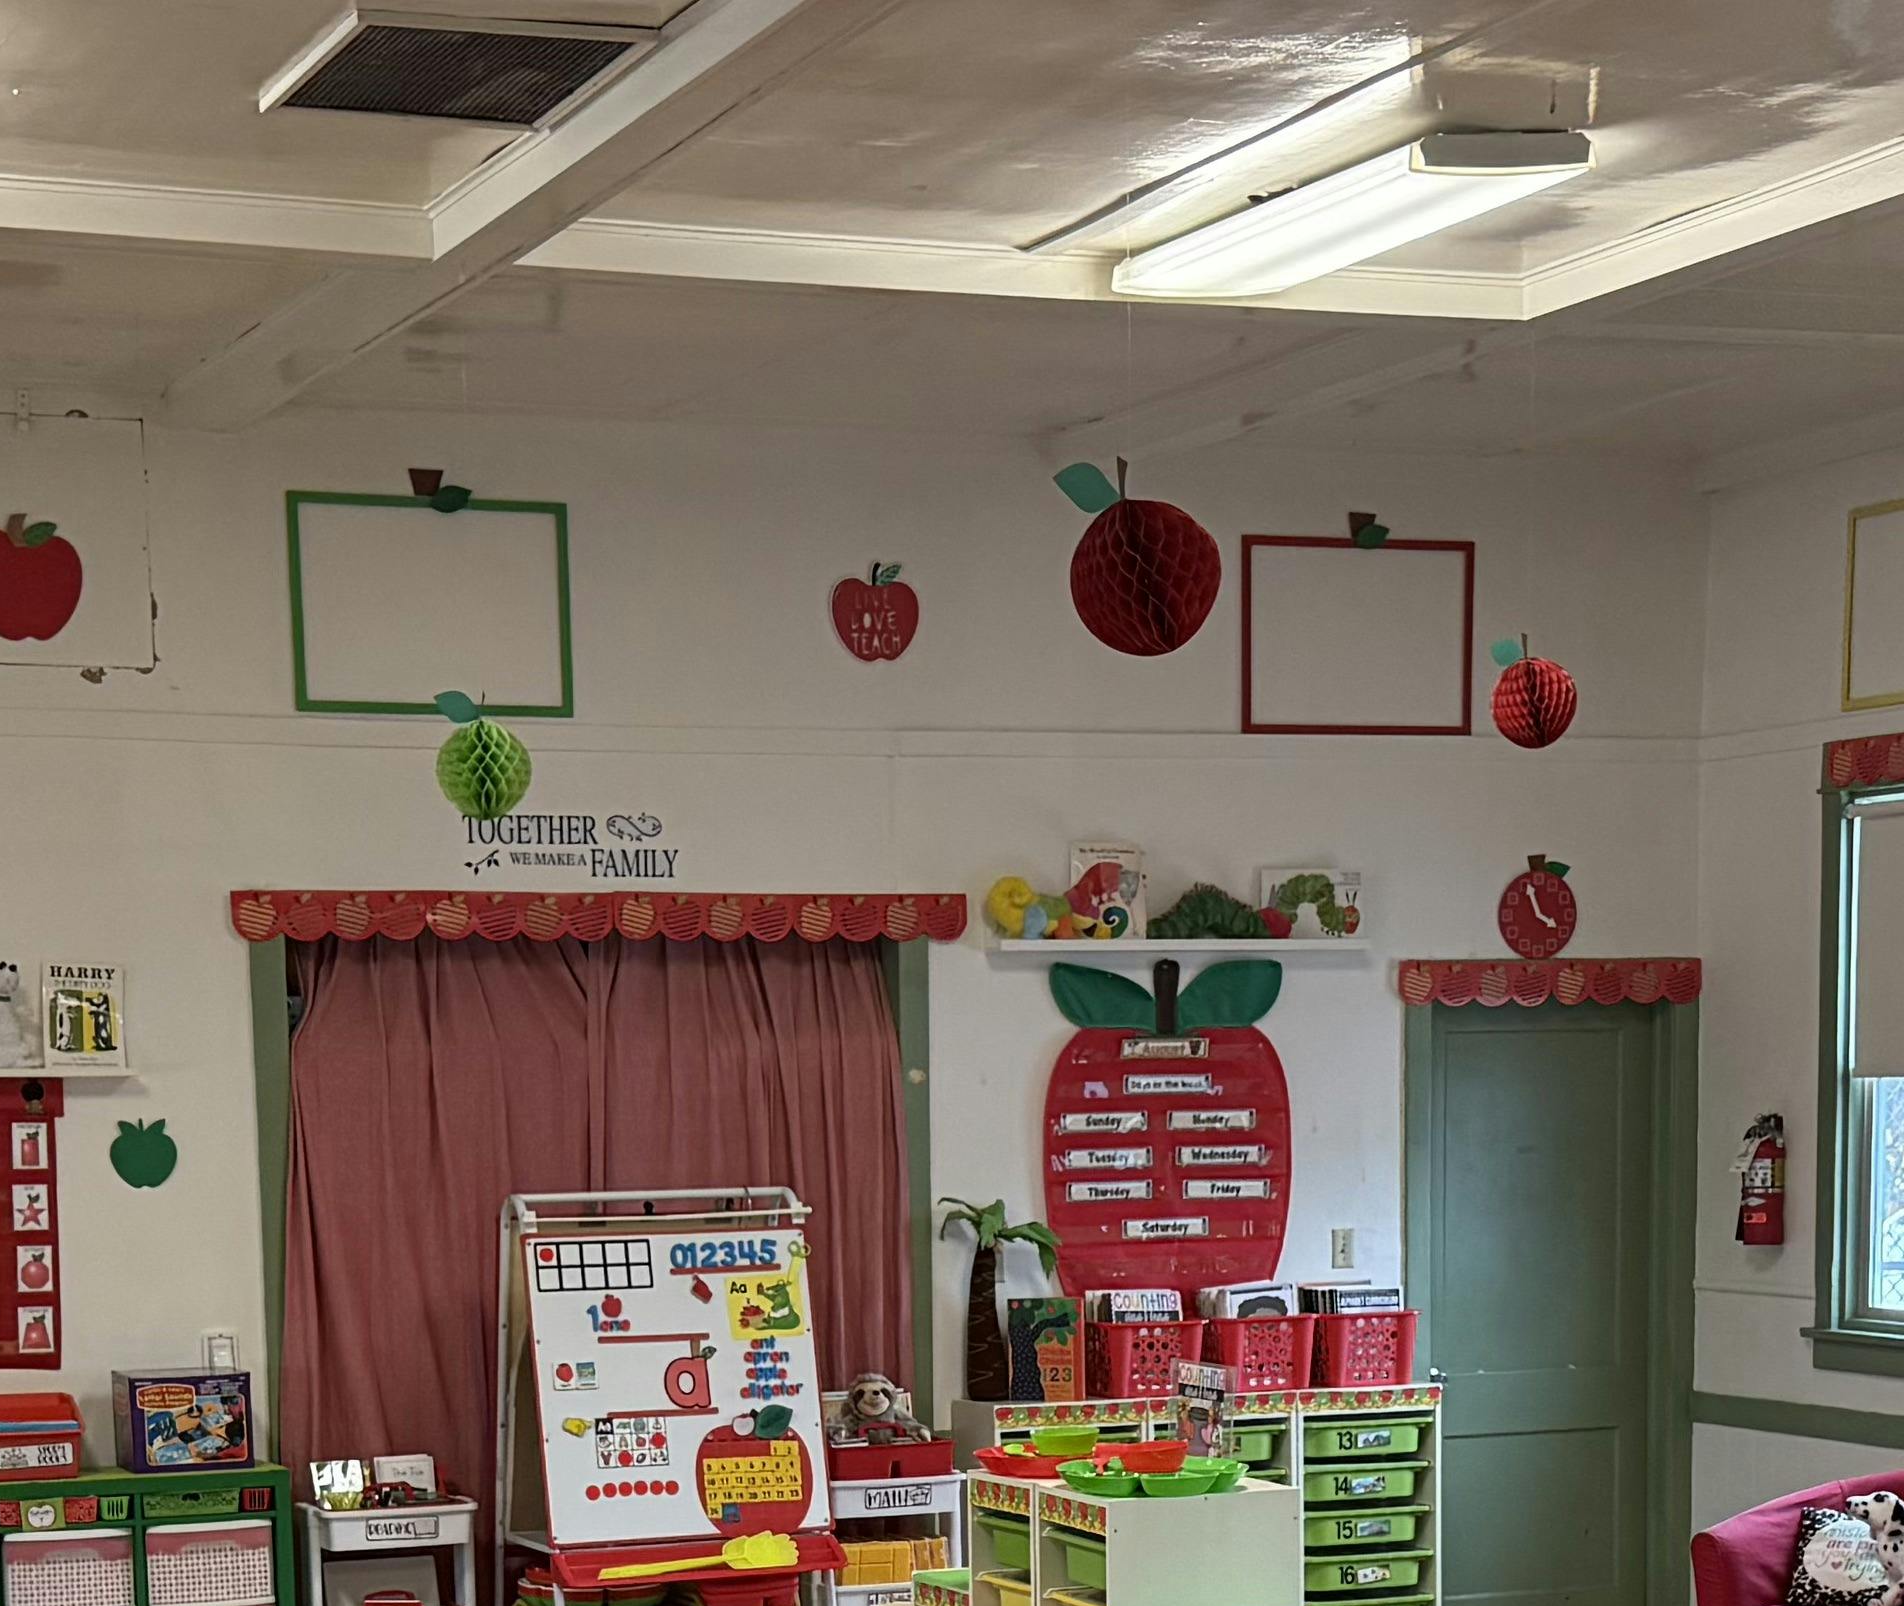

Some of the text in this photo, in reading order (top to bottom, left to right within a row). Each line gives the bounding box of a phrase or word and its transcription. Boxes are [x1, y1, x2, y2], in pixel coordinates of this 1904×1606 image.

[462, 814, 598, 844] TOGETHER
[509, 849, 678, 877] WE MAKE A FAMILY
[50, 965, 115, 980] HARRY
[1085, 1116, 1122, 1128] Sunday
[1088, 1151, 1130, 1164] Tuesday
[1191, 1150, 1249, 1163] Wednesday
[1088, 1186, 1131, 1199] Thursday
[1210, 1184, 1241, 1197] Friday
[1141, 1222, 1189, 1235] Saturday
[670, 1238, 777, 1268] 012345
[730, 1281, 747, 1294] Aa
[1112, 1291, 1178, 1311] Counting
[750, 1335, 776, 1350] ant
[744, 1351, 789, 1365] apron
[664, 1356, 711, 1408] a
[746, 1365, 787, 1383] apple
[740, 1382, 803, 1400] alligator
[1337, 1431, 1353, 1450] 13
[1333, 1476, 1352, 1494] 14
[1335, 1520, 1353, 1539] 15
[1339, 1566, 1356, 1583] 16
